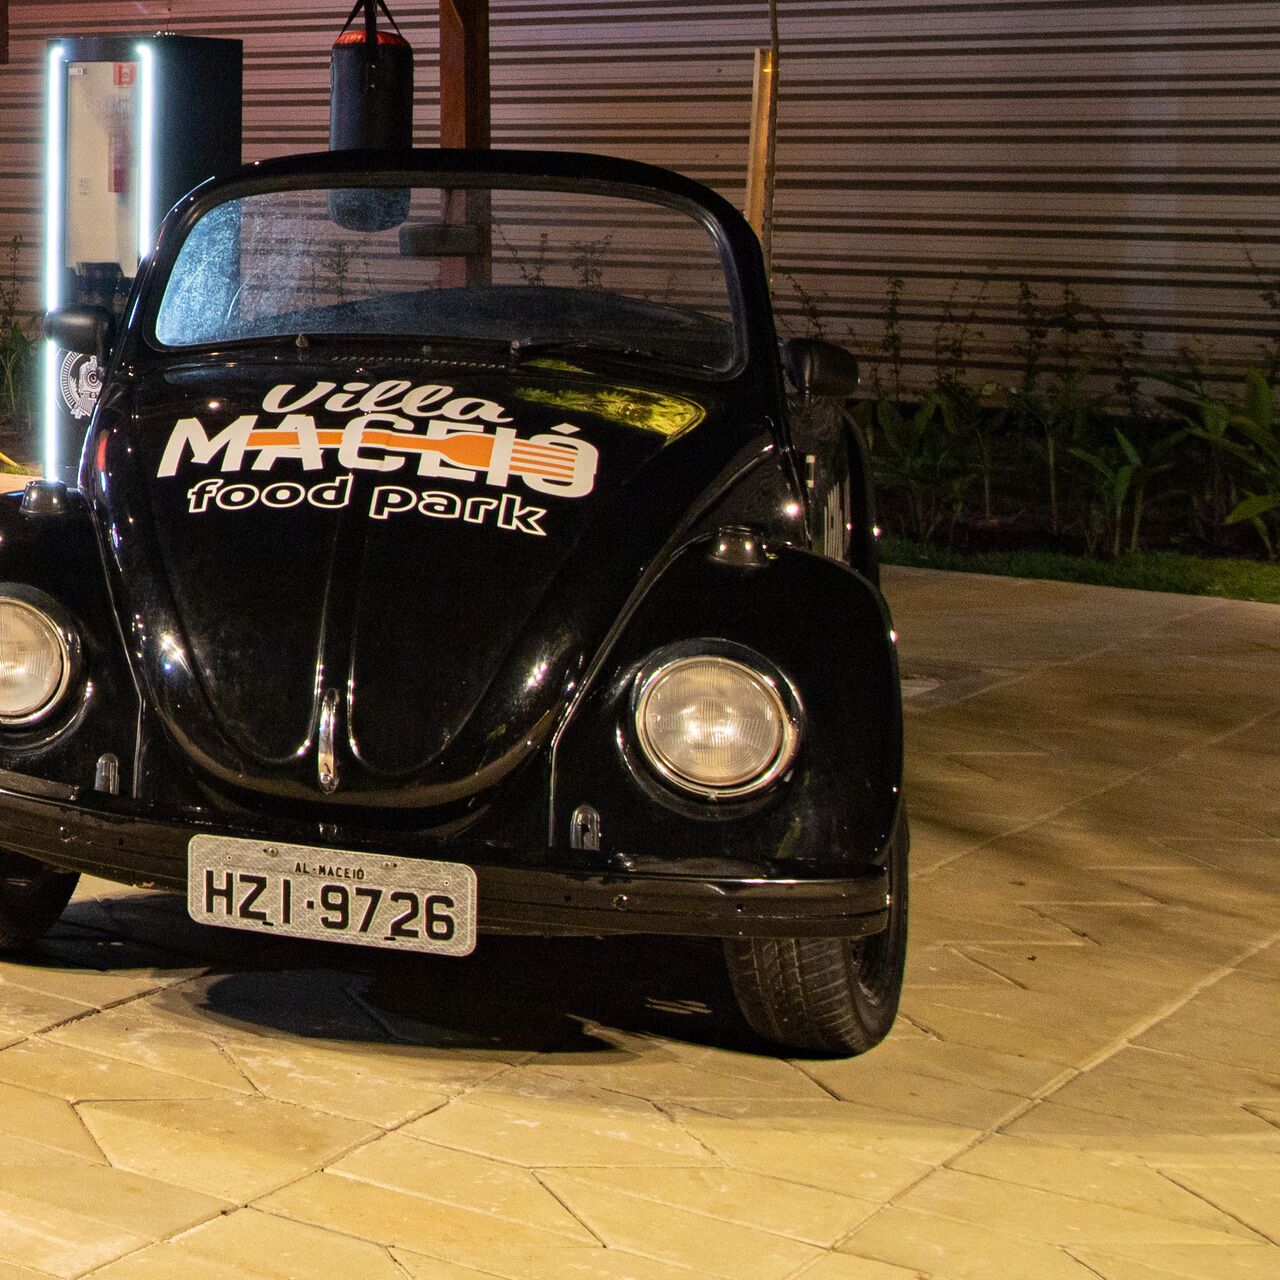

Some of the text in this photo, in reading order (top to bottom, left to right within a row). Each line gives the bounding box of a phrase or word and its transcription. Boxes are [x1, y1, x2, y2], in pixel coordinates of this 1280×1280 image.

[261, 379, 515, 423] Villa
[156, 411, 600, 499] MACEIÓ
[187, 473, 548, 538] food park
